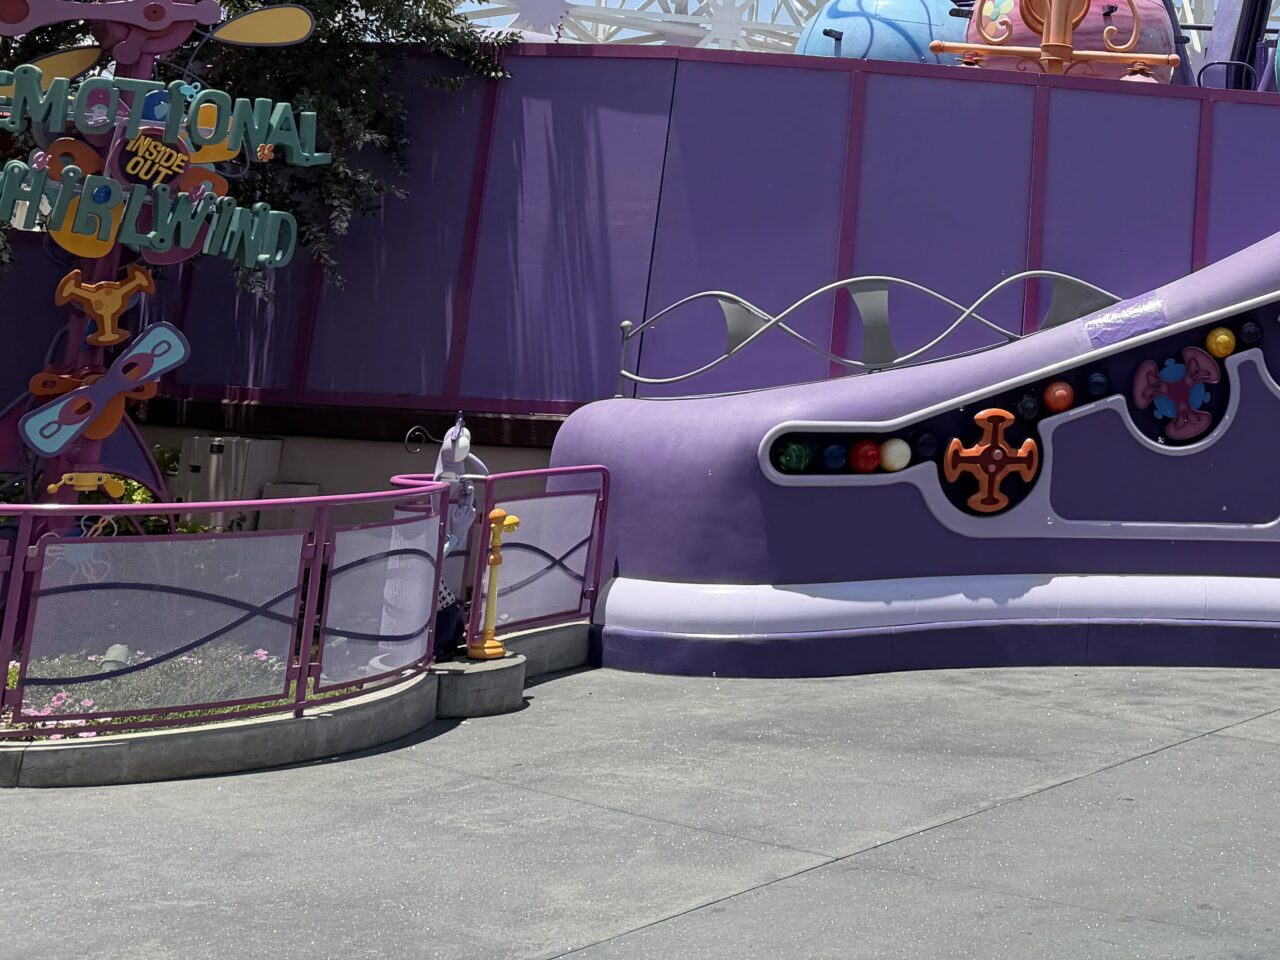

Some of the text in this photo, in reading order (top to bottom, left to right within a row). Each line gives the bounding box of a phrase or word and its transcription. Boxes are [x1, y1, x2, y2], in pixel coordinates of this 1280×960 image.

[125, 135, 189, 174] INSIDE
[125, 156, 173, 185] OUT
[0, 148, 298, 269] HIRLWIND
